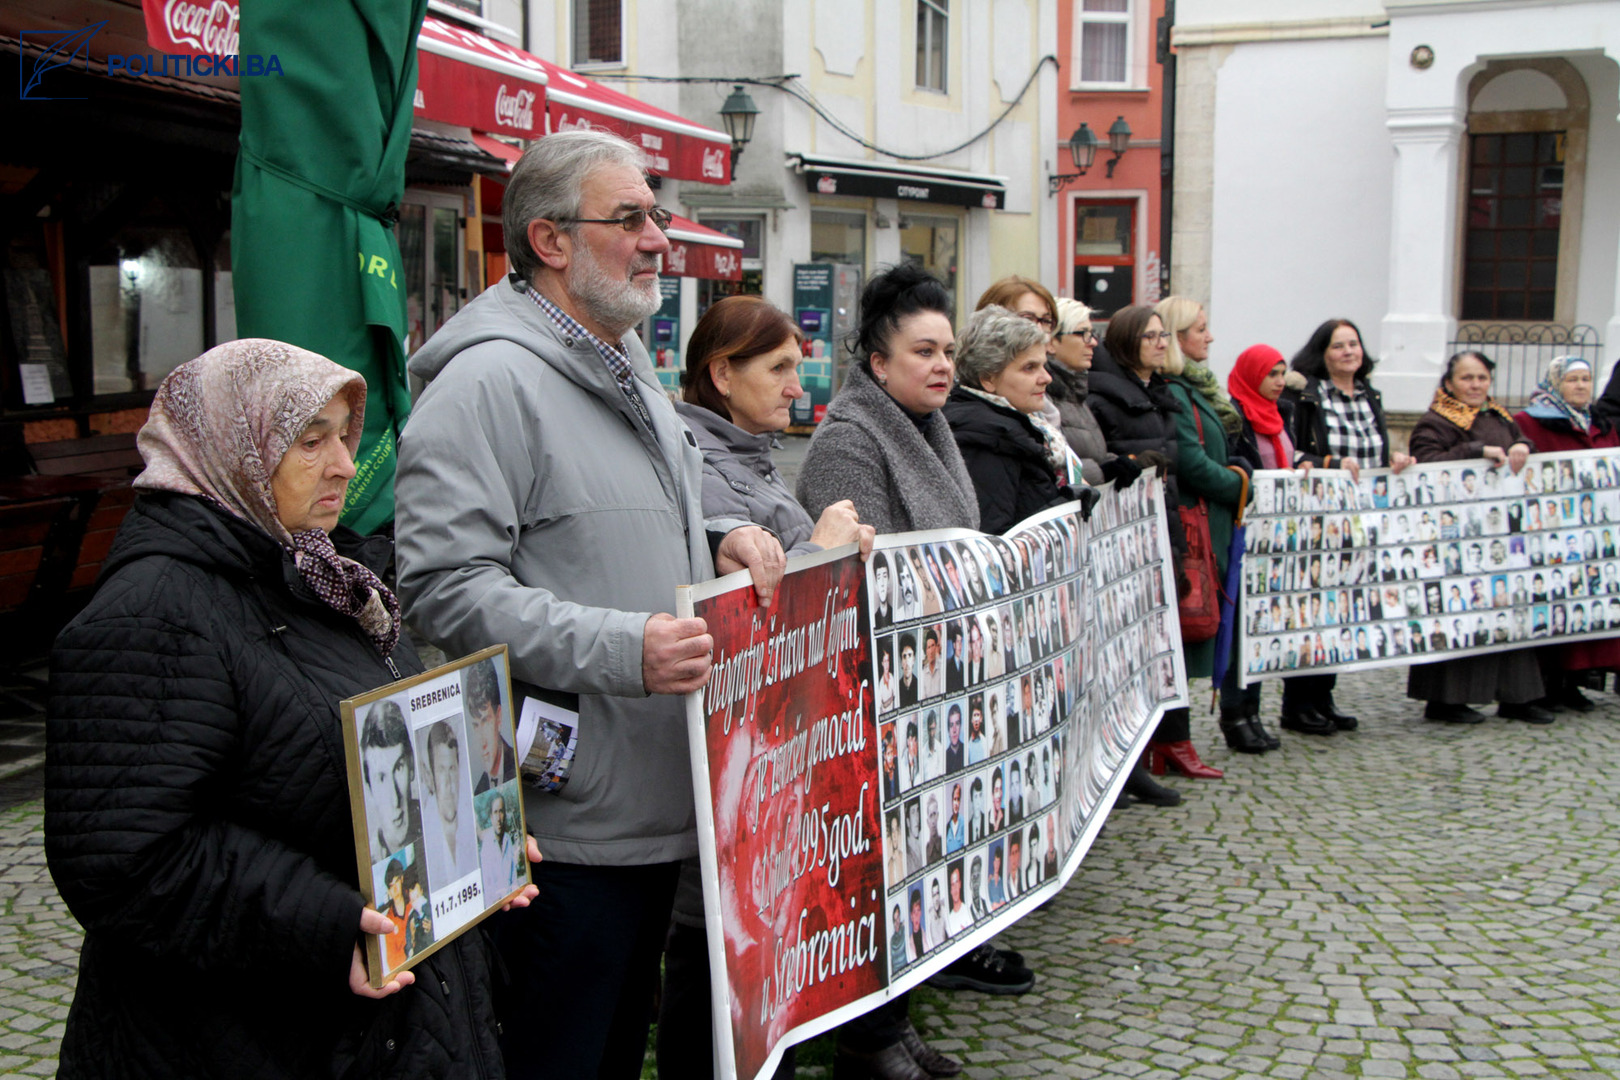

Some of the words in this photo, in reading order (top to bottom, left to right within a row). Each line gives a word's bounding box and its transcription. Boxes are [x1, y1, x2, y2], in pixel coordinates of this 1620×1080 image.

[348, 470, 375, 505] DANISH
[410, 683, 461, 712] SREBRENICA
[702, 613, 765, 736] otografije
[752, 732, 768, 835] je
[804, 678, 868, 795] genocid
[435, 883, 481, 918] 11.7.1995.
[760, 975, 771, 1026] u
[769, 888, 878, 1021] Srebrenici
